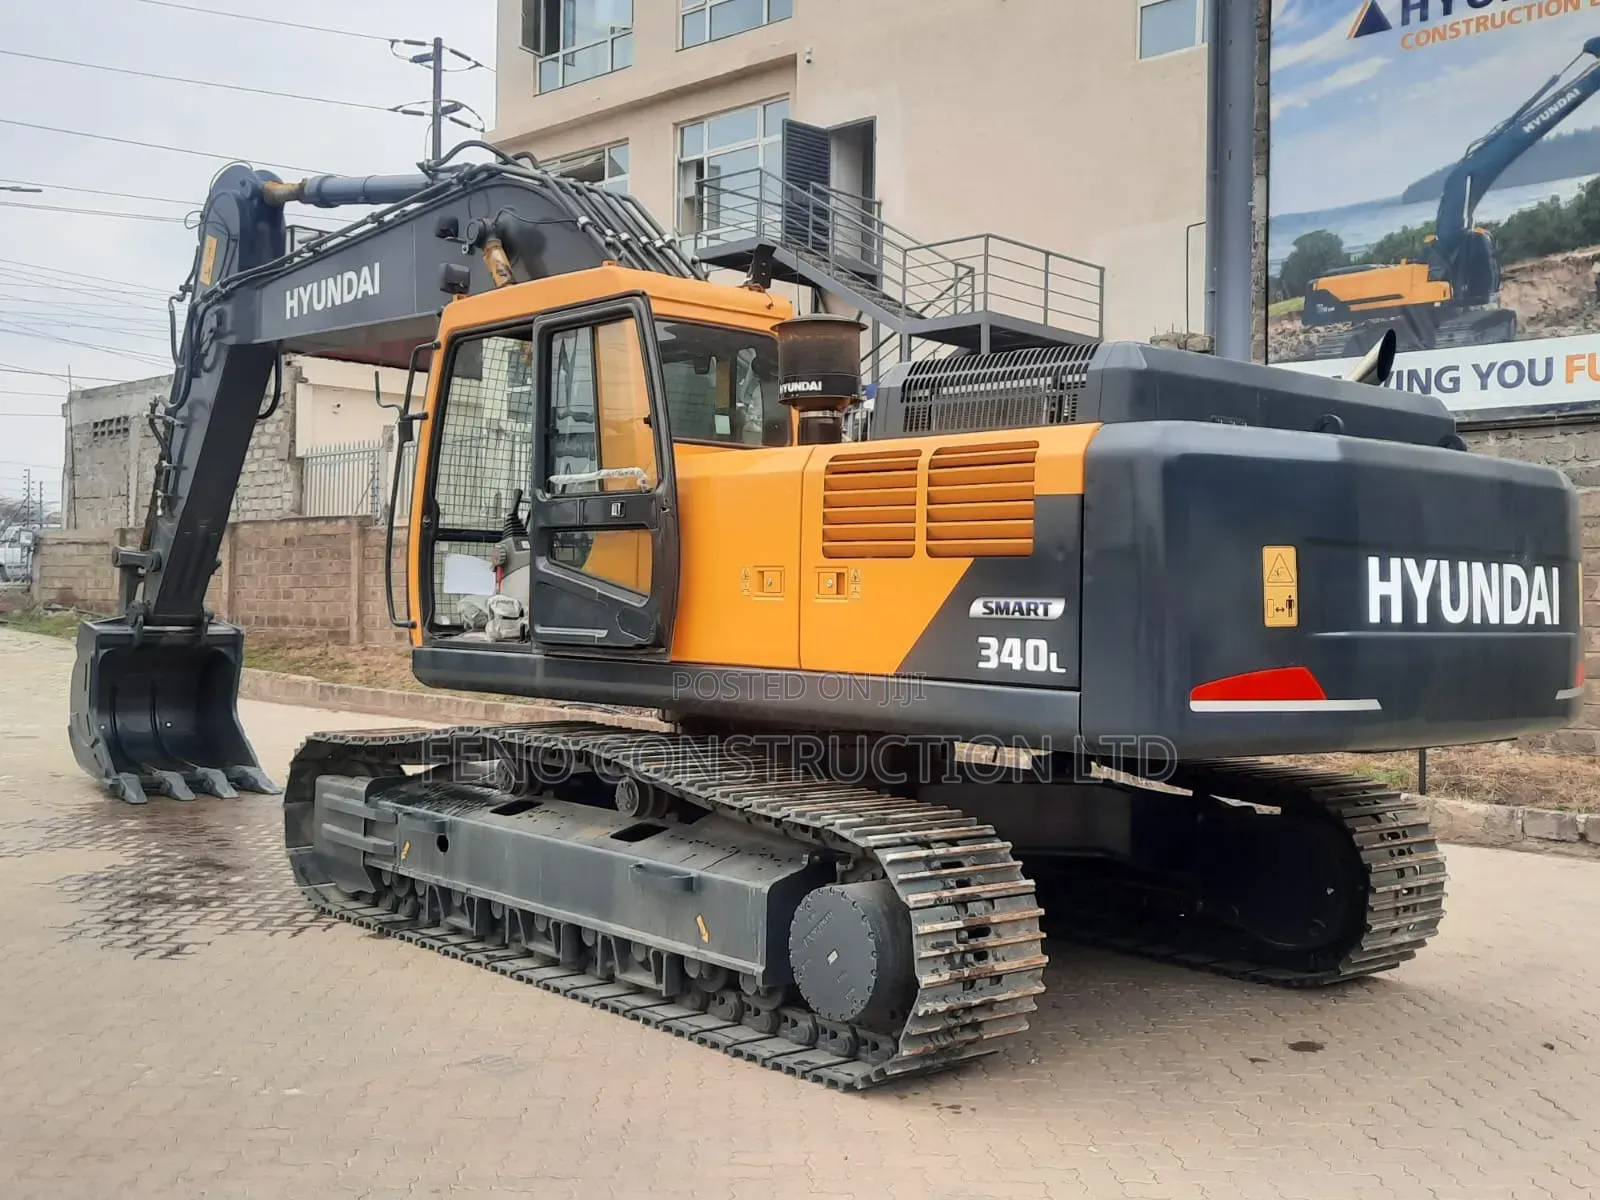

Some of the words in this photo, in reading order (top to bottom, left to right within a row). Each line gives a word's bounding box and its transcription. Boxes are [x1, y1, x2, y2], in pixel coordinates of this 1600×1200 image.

[1401, 0, 1580, 50] CONSTRUCTION
[1523, 88, 1581, 133] HYUNDAI
[285, 262, 380, 320] HYUNDAI
[1472, 356, 1554, 390] YOU
[982, 600, 1053, 617] SMART
[1367, 556, 1560, 625] HYUNDAI
[977, 636, 1067, 673] 340L
